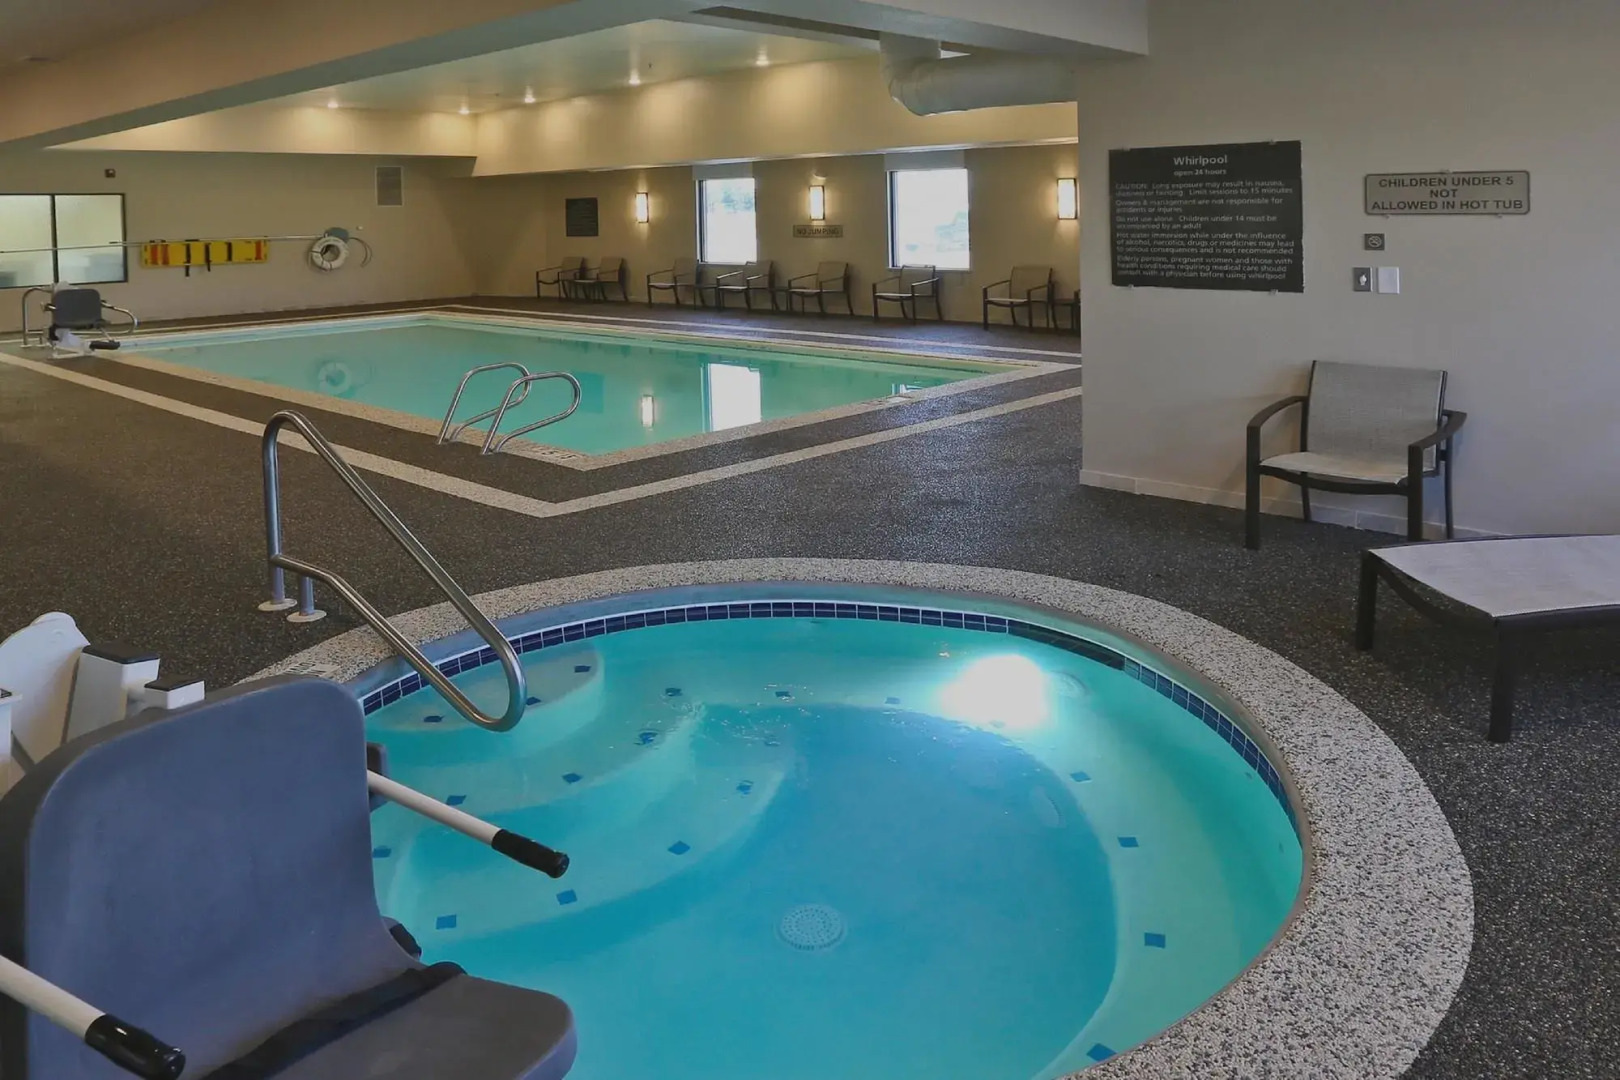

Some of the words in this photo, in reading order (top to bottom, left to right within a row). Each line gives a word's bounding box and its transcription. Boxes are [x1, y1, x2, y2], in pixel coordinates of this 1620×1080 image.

[1174, 154, 1228, 166] Whirlpool
[1378, 177, 1447, 188] CHILDREN
[1452, 176, 1501, 186] UNDER
[1505, 176, 1514, 185] 5
[1430, 188, 1458, 198] NOT
[1372, 201, 1438, 210] ALLOWED
[1442, 200, 1455, 210] IN
[1460, 200, 1488, 209] HOT
[1494, 200, 1522, 209] TUB
